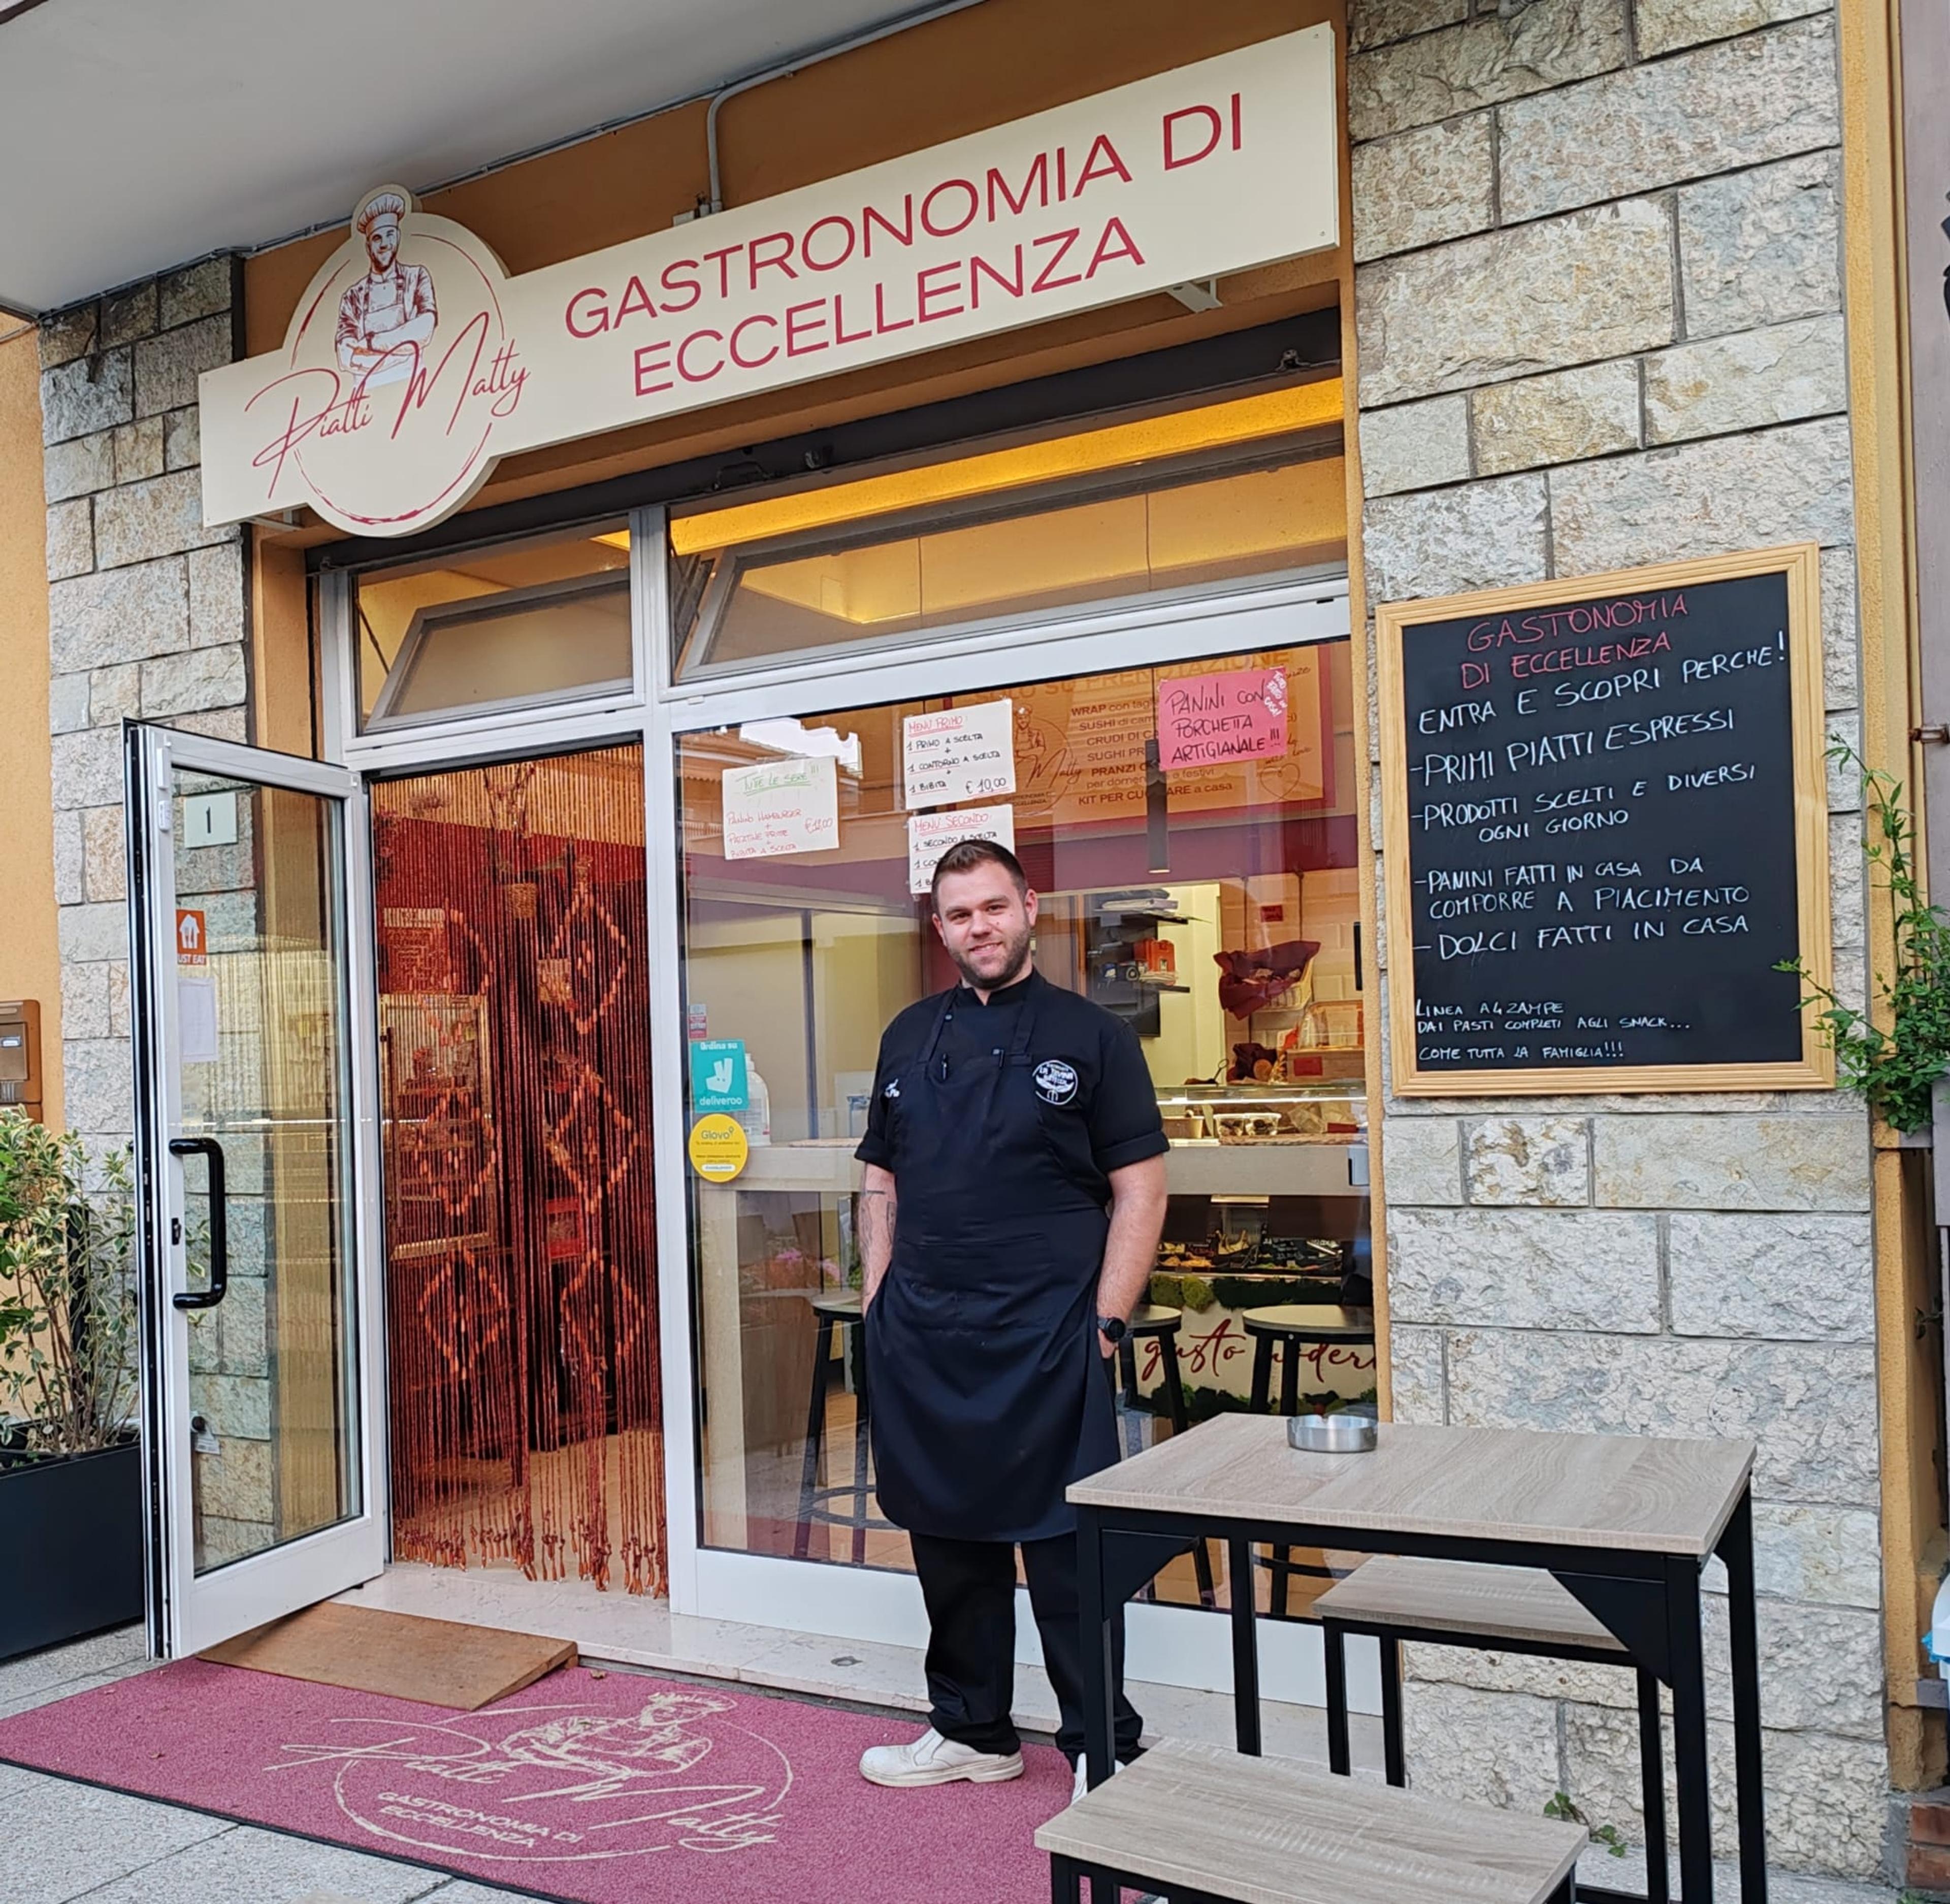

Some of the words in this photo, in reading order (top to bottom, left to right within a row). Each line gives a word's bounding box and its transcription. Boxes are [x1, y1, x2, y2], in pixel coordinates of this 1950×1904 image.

[565, 134, 1132, 339] GASTRONOMIA
[1163, 92, 1242, 171] DI
[634, 217, 1146, 396] ECCELLENZA
[358, 311, 531, 440] Matty
[1468, 595, 1687, 651] GASTONOMIA
[1461, 663, 1489, 688] DI
[1512, 633, 1670, 677] ECCELLENZA
[1166, 682, 1225, 715] PANINI
[1238, 678, 1265, 704] CON
[1419, 701, 1496, 734] ENTRA
[1518, 689, 1537, 714] E
[1555, 668, 1660, 706] SCOPRI
[1071, 704, 1107, 716] WRAP
[1109, 702, 1129, 711] con
[936, 715, 963, 729] PRIMO
[1079, 718, 1116, 731] SUSHI
[1118, 716, 1128, 726] di
[1171, 714, 1253, 739] PORCHETTA
[906, 741, 912, 751] 1
[916, 739, 940, 749] PRIMO
[954, 733, 983, 743] SCELTA
[1087, 734, 1124, 746] CRUDI
[1127, 732, 1140, 741] DI
[1171, 735, 1265, 763] ARTIGIANALE
[1507, 732, 1592, 771] PIATTI
[1605, 709, 1733, 749] ESPRESSI
[907, 763, 914, 772] 1
[919, 758, 960, 770] CONTORNO
[972, 750, 1000, 761] SCELTA
[1087, 749, 1125, 762] SUGHI
[769, 772, 779, 785] LE
[1087, 780, 1107, 792] per
[1182, 768, 1214, 778] festivi
[1092, 764, 1135, 777] PRANZI
[909, 783, 915, 793] 1
[919, 780, 947, 791] BIBITA
[1078, 795, 1096, 806] KIT
[1100, 793, 1123, 803] PER
[1204, 782, 1232, 792] casa
[1534, 786, 1613, 812] SCELTI
[1633, 781, 1646, 796] E
[1668, 764, 1754, 791] DIVERSI
[206, 805, 211, 834] 1
[946, 813, 989, 827] SECONDO
[1479, 823, 1529, 842] OGNI
[1545, 810, 1628, 833] GIORNO
[913, 842, 919, 851] 1
[923, 835, 958, 847] SECONDO
[1505, 865, 1555, 885] FATTI
[1567, 865, 1583, 883] IN
[1596, 862, 1641, 876] CASA
[1671, 858, 1703, 874] DA
[1430, 891, 1534, 918] COMPORRE
[1557, 891, 1573, 911] A
[1595, 887, 1748, 909] PIACIMENTO
[1439, 931, 1515, 960] DOLCI
[1538, 926, 1611, 948] FATTI
[1634, 921, 1664, 939] IN
[1683, 915, 1748, 934] CASA
[177, 954, 191, 964] UST
[193, 954, 205, 964] EAT
[1416, 999, 1462, 1017] LINEA
[1507, 1002, 1563, 1014] ZAMPE
[1418, 1021, 1442, 1033] DAI
[1454, 1020, 1493, 1031] PASTI
[1505, 1019, 1561, 1029] COMPLETI
[1578, 1017, 1607, 1028] AGLI
[700, 1041, 726, 1051] Ordina
[1419, 1047, 1460, 1060] COME
[1467, 1048, 1504, 1059] TUTTA
[1514, 1047, 1528, 1058] LA
[699, 1095, 742, 1106] deliveroo
[378, 1792, 549, 1836] GASTRONOMIA
[553, 1831, 584, 1844] DI
[379, 1805, 535, 1848] ECCELLENZA
